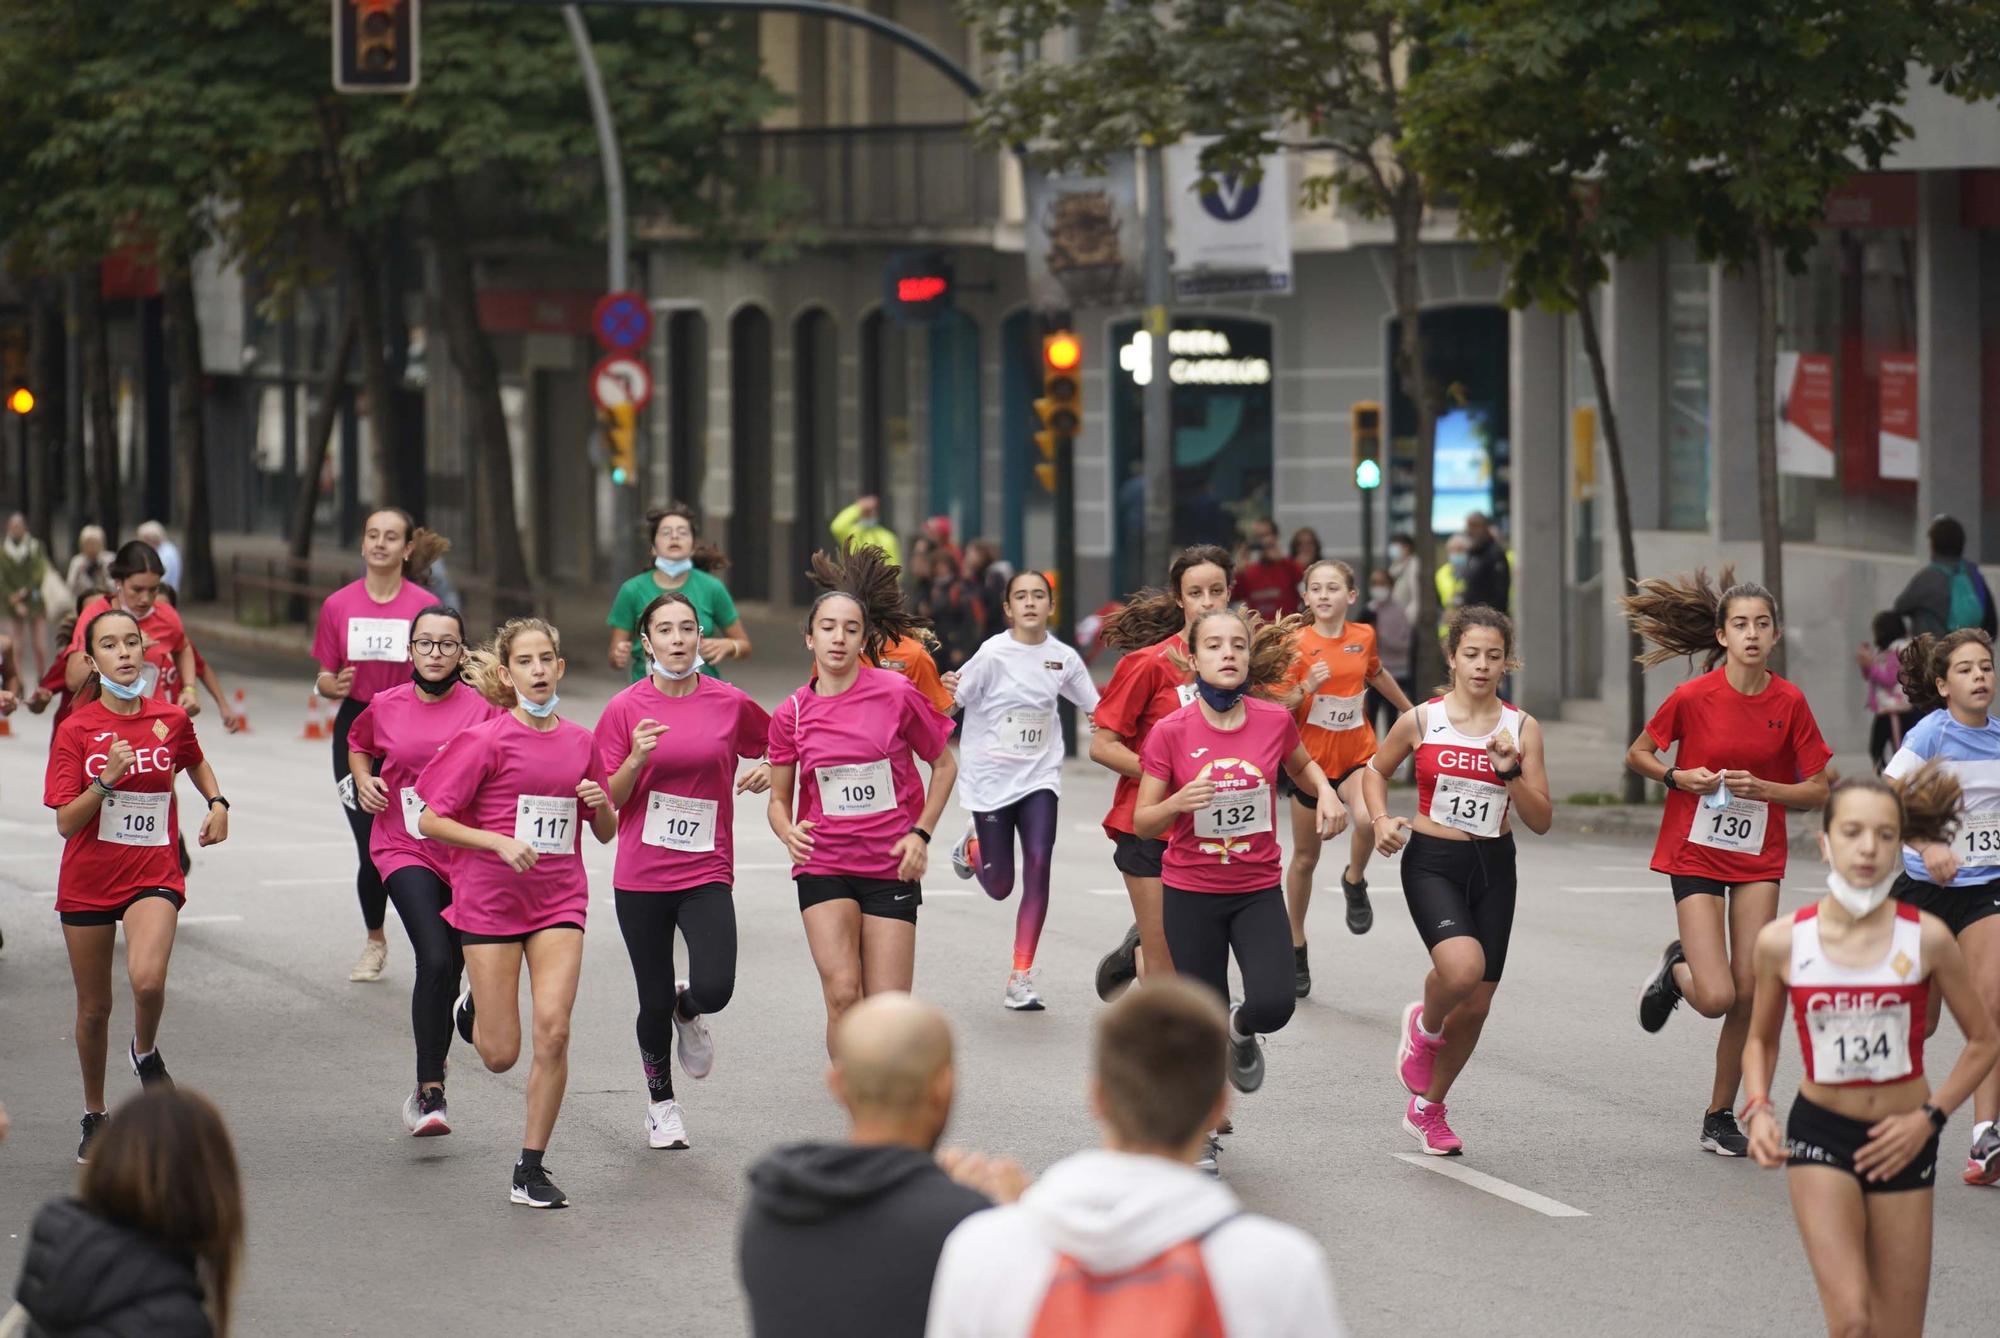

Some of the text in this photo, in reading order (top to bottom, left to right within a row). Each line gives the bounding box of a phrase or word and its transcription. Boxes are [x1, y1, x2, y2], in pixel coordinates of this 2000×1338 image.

[366, 636, 393, 649] 112
[1330, 710, 1354, 722] 104
[1020, 729, 1042, 742] 101
[842, 785, 876, 802] 109
[1212, 805, 1256, 826] 132
[1450, 796, 1490, 822] 131
[123, 814, 156, 832] 108
[534, 816, 568, 839] 117
[667, 818, 700, 837] 107
[1712, 814, 1752, 839] 130
[1965, 830, 2000, 852] 133
[1834, 1032, 1892, 1064] 134
